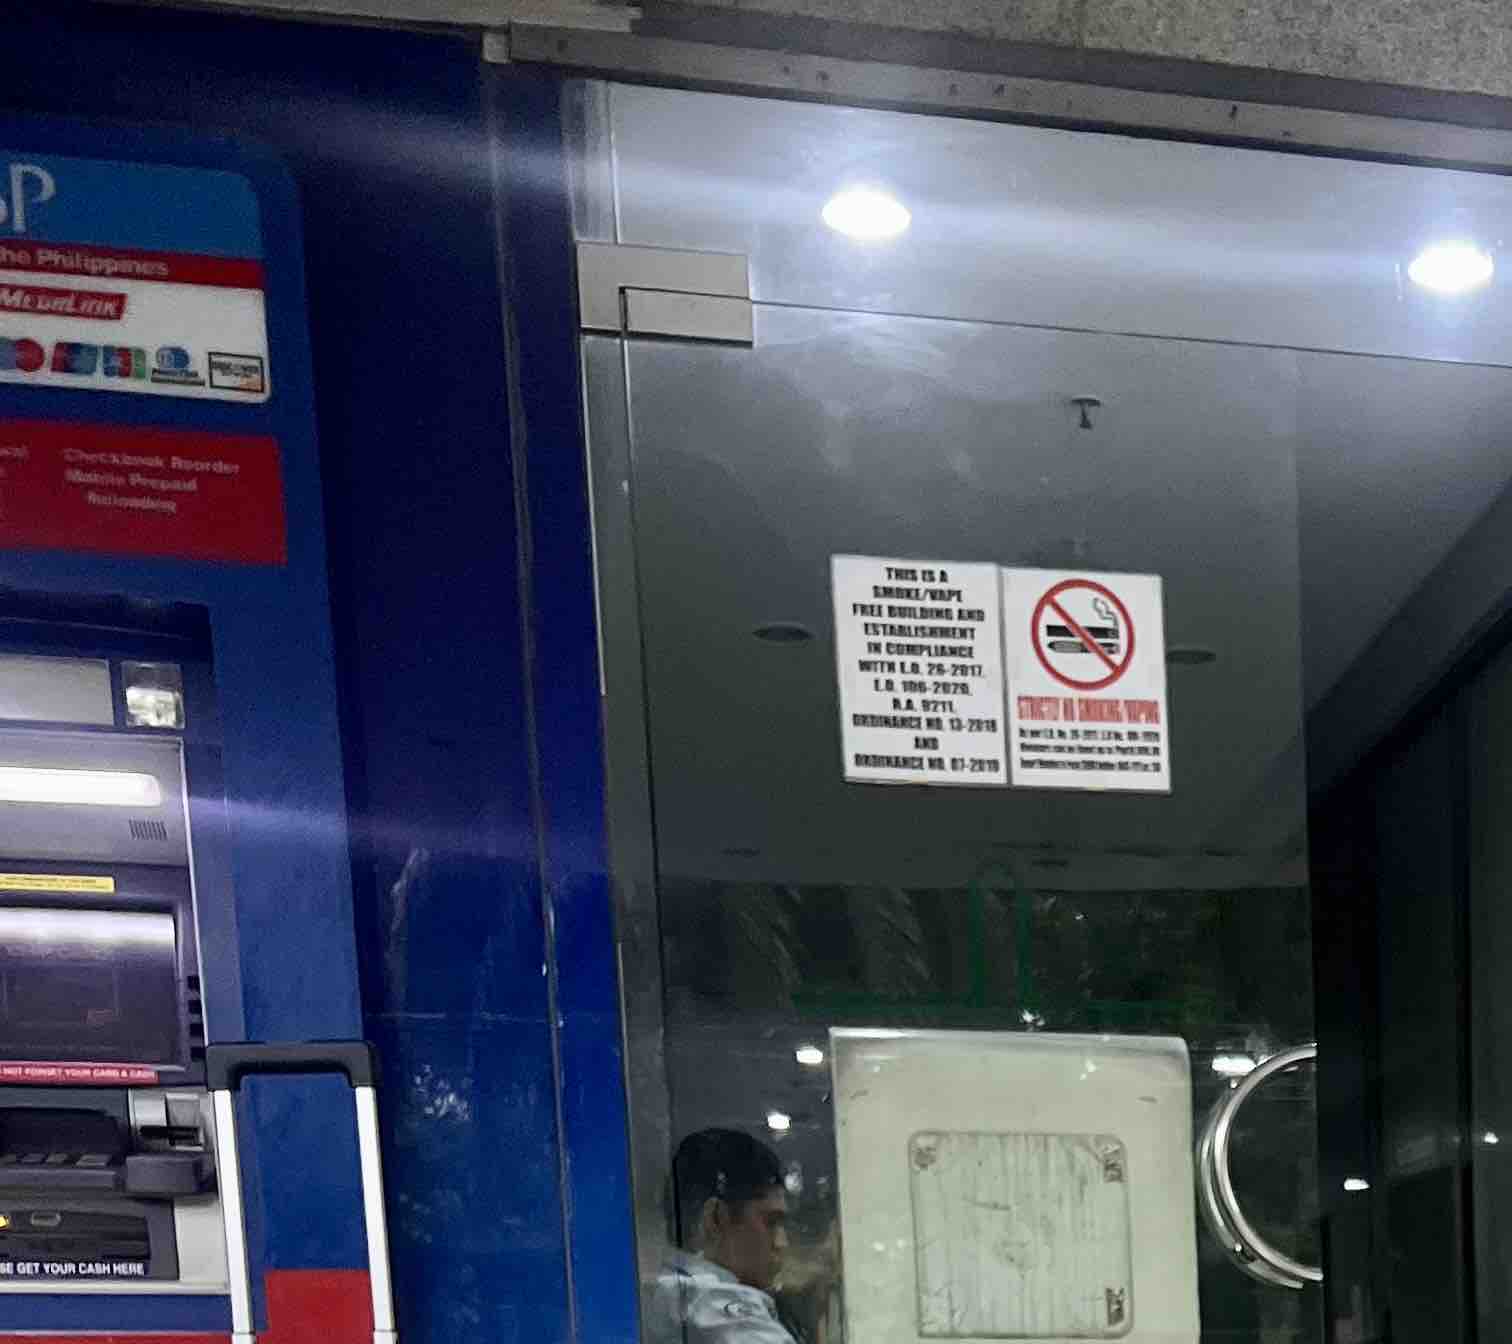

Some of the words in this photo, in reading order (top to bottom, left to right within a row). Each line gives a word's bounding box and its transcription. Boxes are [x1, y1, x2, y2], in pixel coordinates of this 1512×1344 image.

[0, 247, 31, 265] he
[37, 248, 169, 276] Philippines
[885, 566, 918, 582] THIS
[921, 569, 936, 583] IS
[939, 569, 949, 583] A
[872, 585, 963, 602] SMOKE/VAPE
[852, 603, 883, 618] FREE
[887, 605, 953, 621] BUILDING
[957, 608, 985, 622] AND
[863, 622, 977, 641] ESTABLISHMENT
[866, 641, 882, 654] IN
[885, 642, 975, 659] COMPLIANCE
[858, 659, 896, 674] WITH
[852, 713, 922, 730] ORDINANCE
[914, 735, 940, 751] AND
[16, 1262, 40, 1275] GET
[42, 1262, 76, 1275] YOUR
[78, 1262, 111, 1276] CASH
[113, 1263, 145, 1276] HERE
